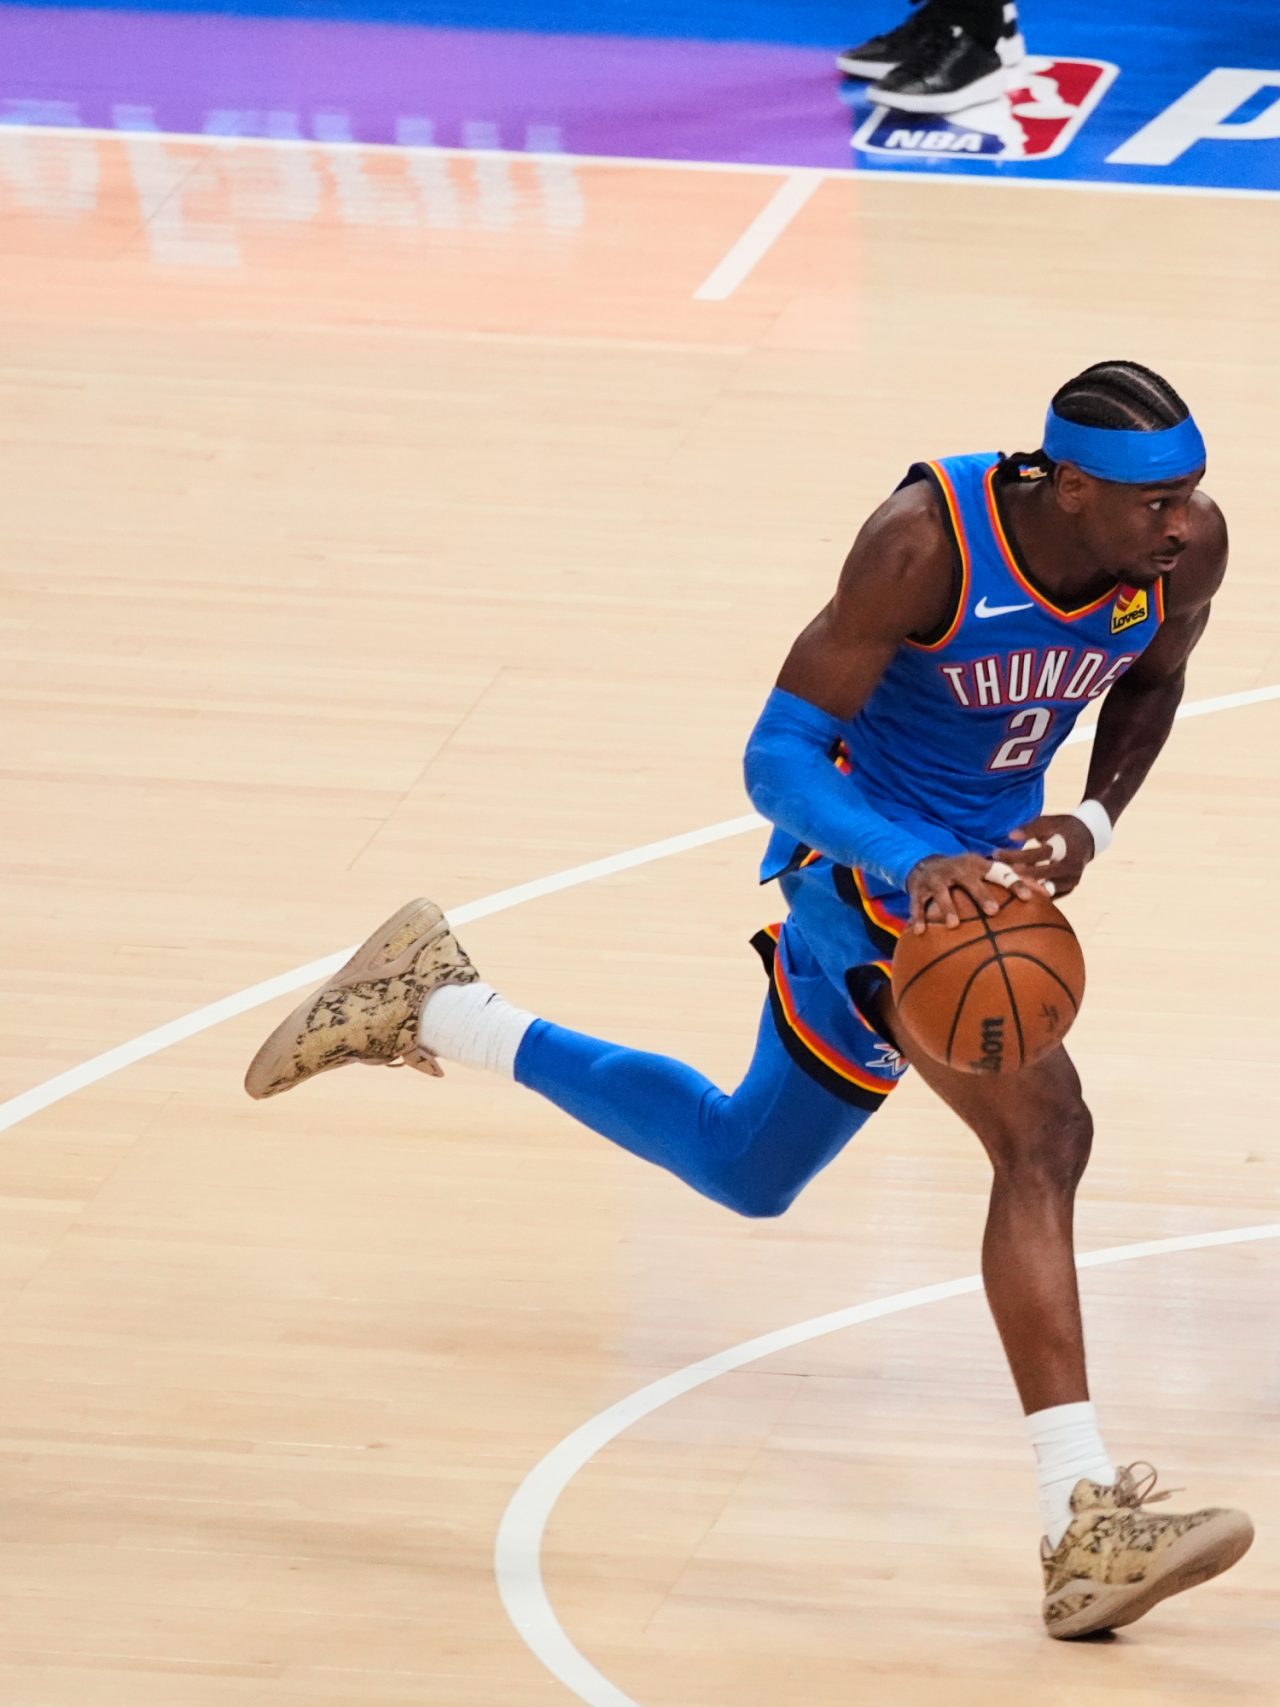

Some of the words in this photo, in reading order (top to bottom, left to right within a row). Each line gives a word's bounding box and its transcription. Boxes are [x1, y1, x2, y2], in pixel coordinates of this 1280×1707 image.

[884, 129, 983, 152] NBA
[940, 649, 1135, 707] THUNDE
[988, 705, 1052, 771] 2
